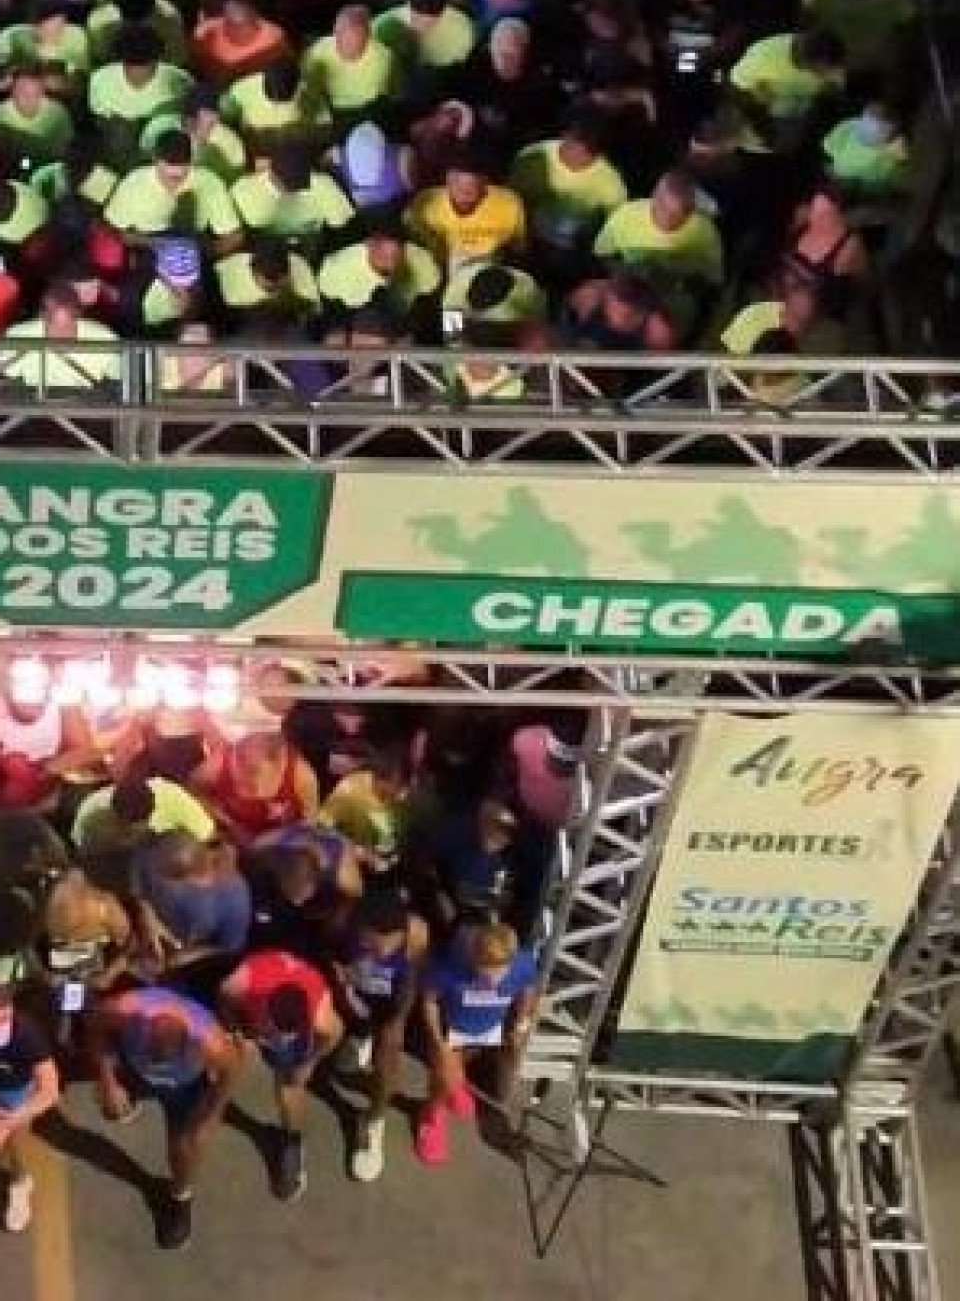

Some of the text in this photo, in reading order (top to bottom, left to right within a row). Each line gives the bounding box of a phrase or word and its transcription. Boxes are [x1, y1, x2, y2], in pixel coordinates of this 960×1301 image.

[126, 527, 278, 561] REIS
[0, 564, 235, 611] 2024
[471, 591, 905, 646] CHEGADA
[687, 831, 863, 856] ESPORTES
[672, 887, 870, 918] Santos
[773, 918, 894, 947] Reis
